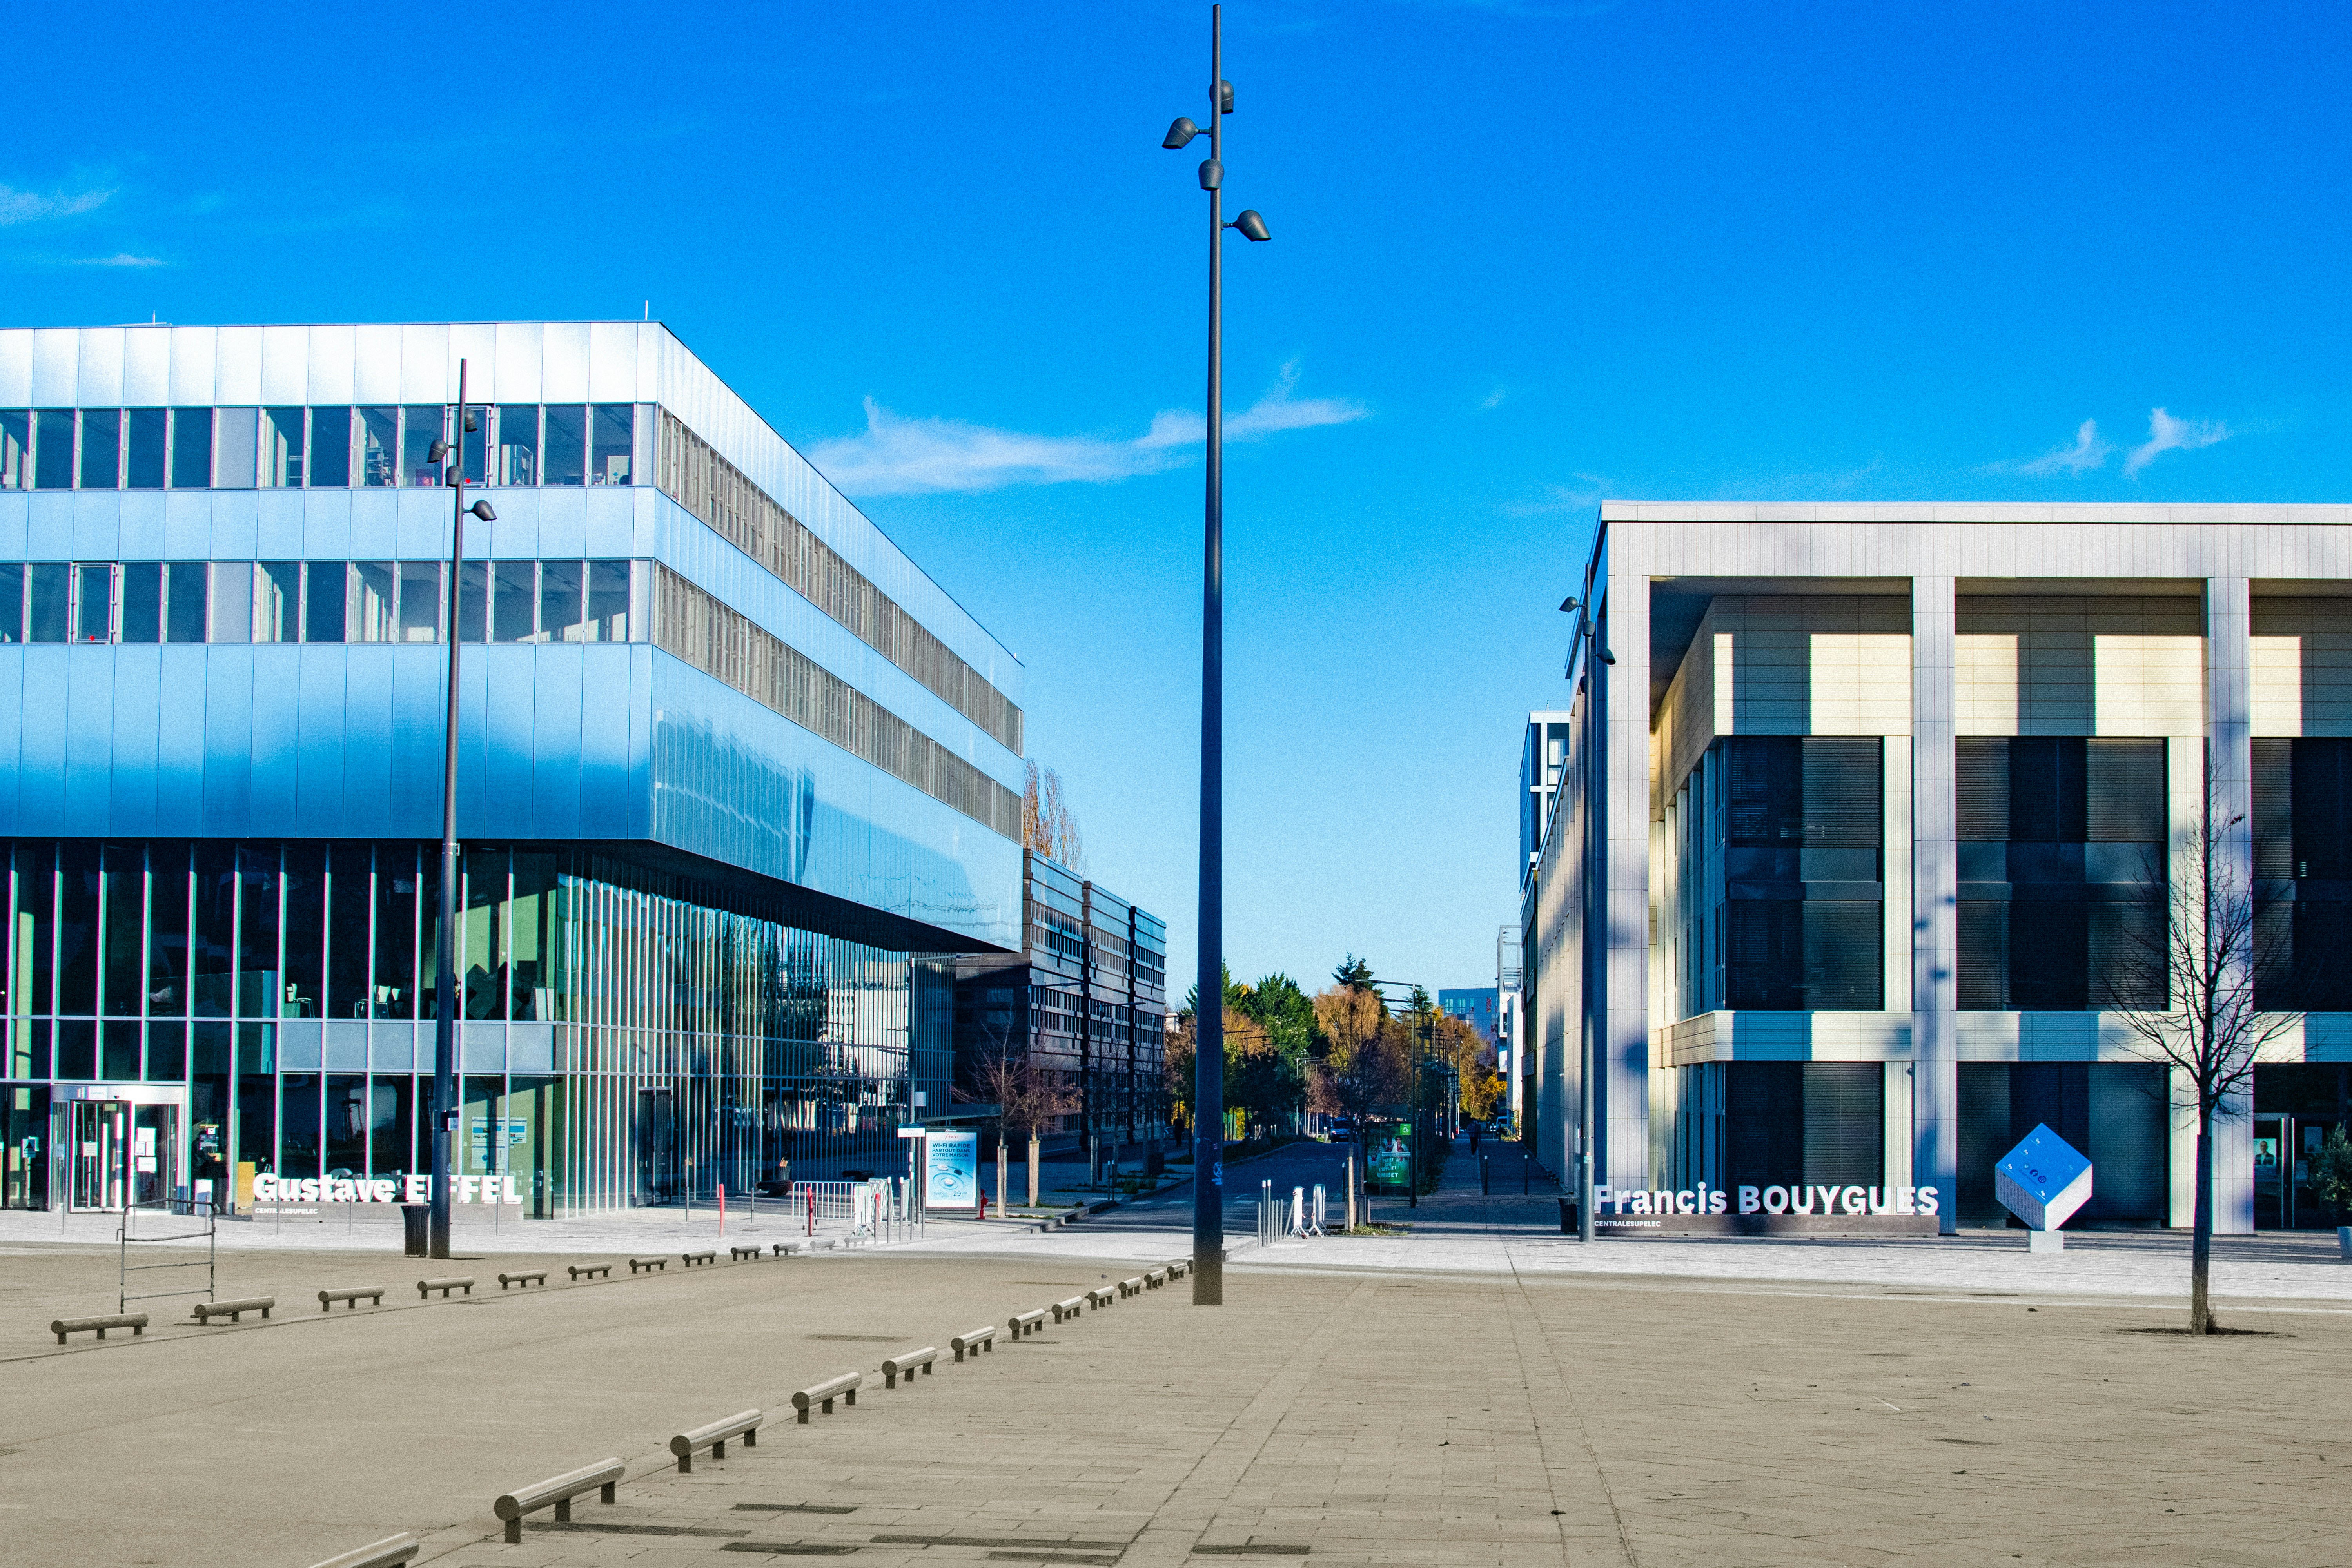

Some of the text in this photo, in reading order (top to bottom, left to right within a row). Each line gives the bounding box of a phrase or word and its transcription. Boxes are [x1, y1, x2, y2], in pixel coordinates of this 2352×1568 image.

[253, 1173, 523, 1202] Gustave EFEL
[1594, 1181, 1938, 1214] Francis BOUYGUES
